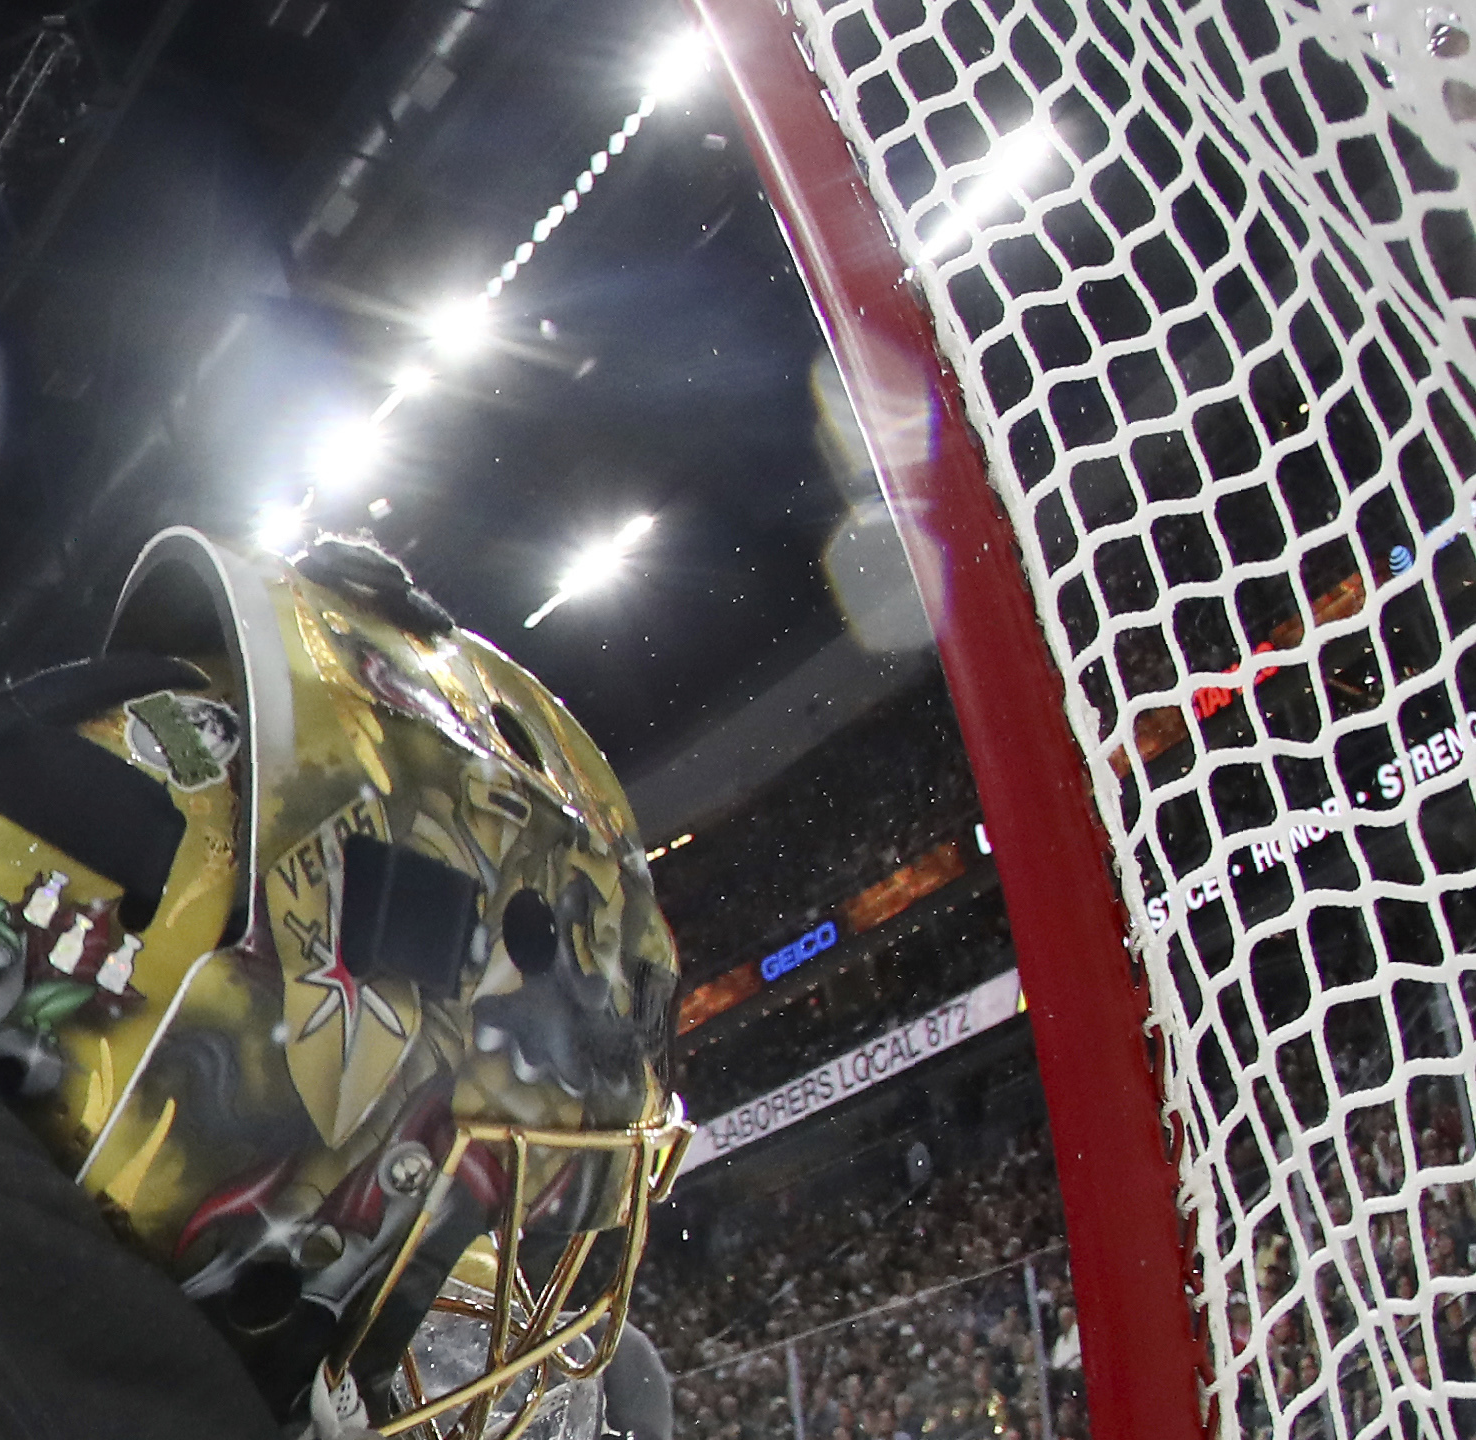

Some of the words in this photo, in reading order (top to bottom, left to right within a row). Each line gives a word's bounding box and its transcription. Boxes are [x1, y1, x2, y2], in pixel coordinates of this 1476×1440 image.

[760, 920, 838, 982] GEICO
[709, 1070, 835, 1150] LABORERS
[837, 1022, 922, 1090] LOCAL
[925, 1003, 971, 1048] 872
